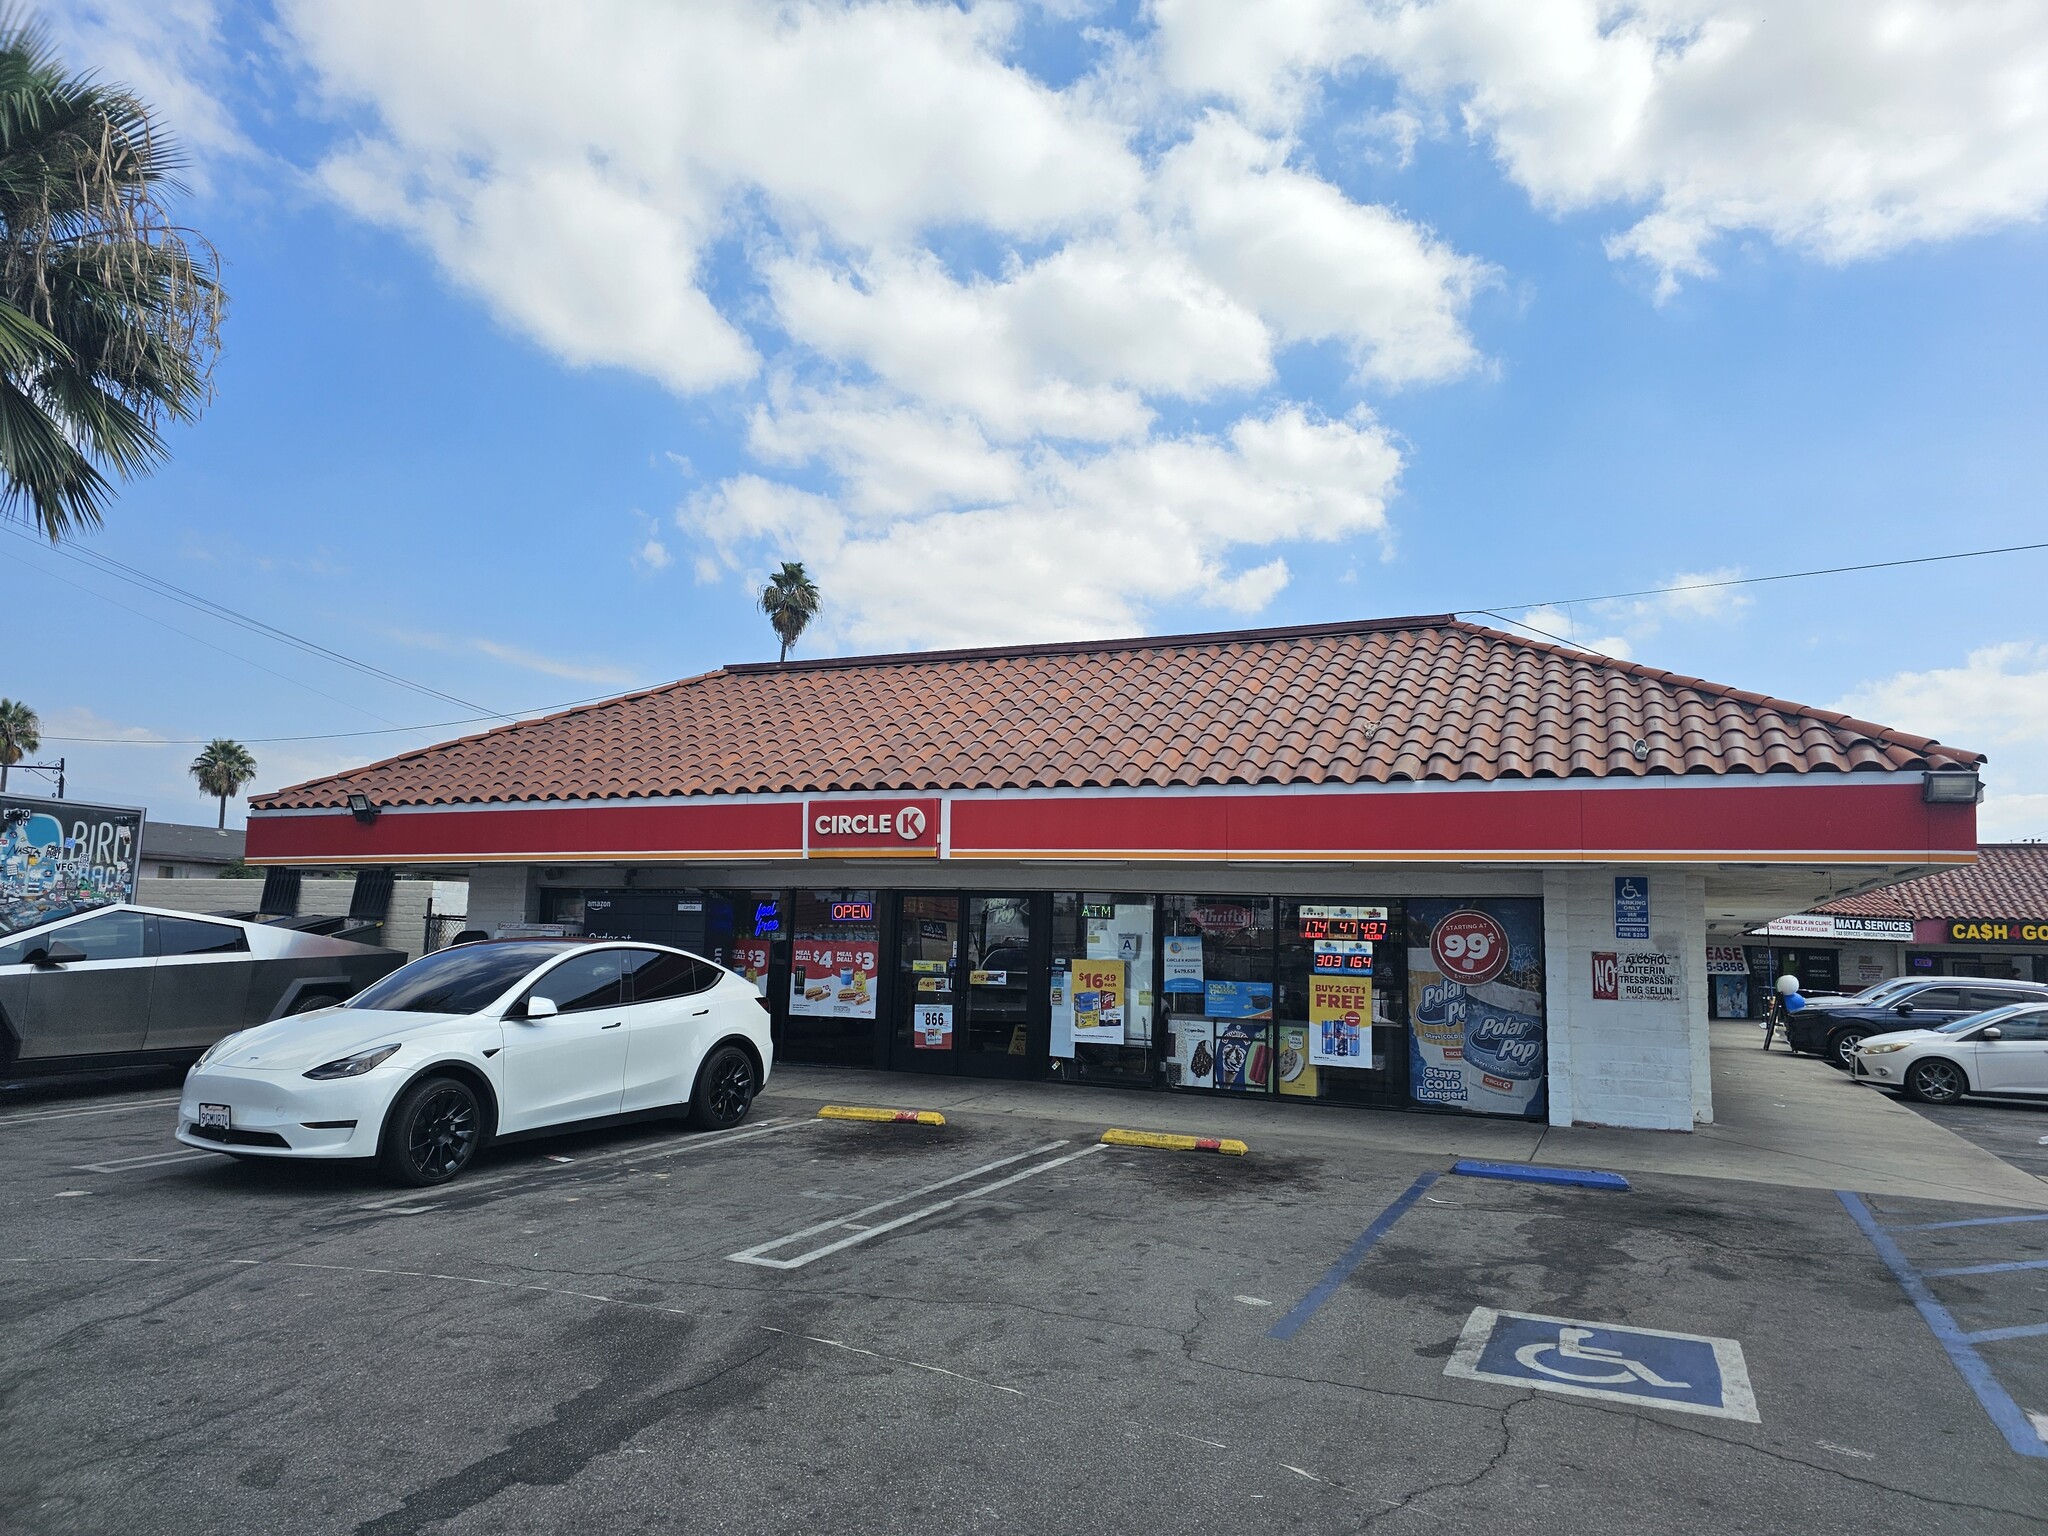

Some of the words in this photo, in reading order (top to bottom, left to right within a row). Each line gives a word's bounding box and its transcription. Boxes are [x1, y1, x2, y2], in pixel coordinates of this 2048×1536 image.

[815, 814, 892, 834] CIRCLE
[900, 810, 923, 838] K
[56, 863, 73, 871] VFG
[834, 905, 870, 918] OPEN
[1081, 905, 1111, 918] ATM
[755, 918, 779, 936] free
[1305, 921, 1327, 933] 174
[1339, 922, 1357, 934] 47
[1360, 922, 1386, 934] 497
[1445, 923, 1478, 931] STARTING
[1836, 919, 1863, 929] MATA
[1864, 920, 1911, 931] SERVICES
[1953, 922, 2008, 941] CA$H
[2009, 925, 2021, 939] 4
[1123, 940, 1131, 950] A
[748, 950, 766, 968] $3
[813, 950, 833, 968] $4
[855, 952, 874, 970] $3
[1316, 955, 1342, 967] 303
[1350, 957, 1372, 967] 164
[1625, 955, 1670, 965] ALCOHOL
[1594, 960, 1615, 993] NO
[1335, 985, 1342, 993] 2
[1342, 986, 1361, 994] GET
[1361, 986, 1366, 994] 1
[1316, 993, 1365, 1010] FREE
[1450, 1002, 1466, 1021] Po
[1480, 1016, 1529, 1036] Polar
[1500, 1039, 1537, 1063] Pop
[1425, 1068, 1460, 1081] Stays
[1426, 1079, 1461, 1090] COLD
[1419, 1089, 1467, 1101] Longer!
